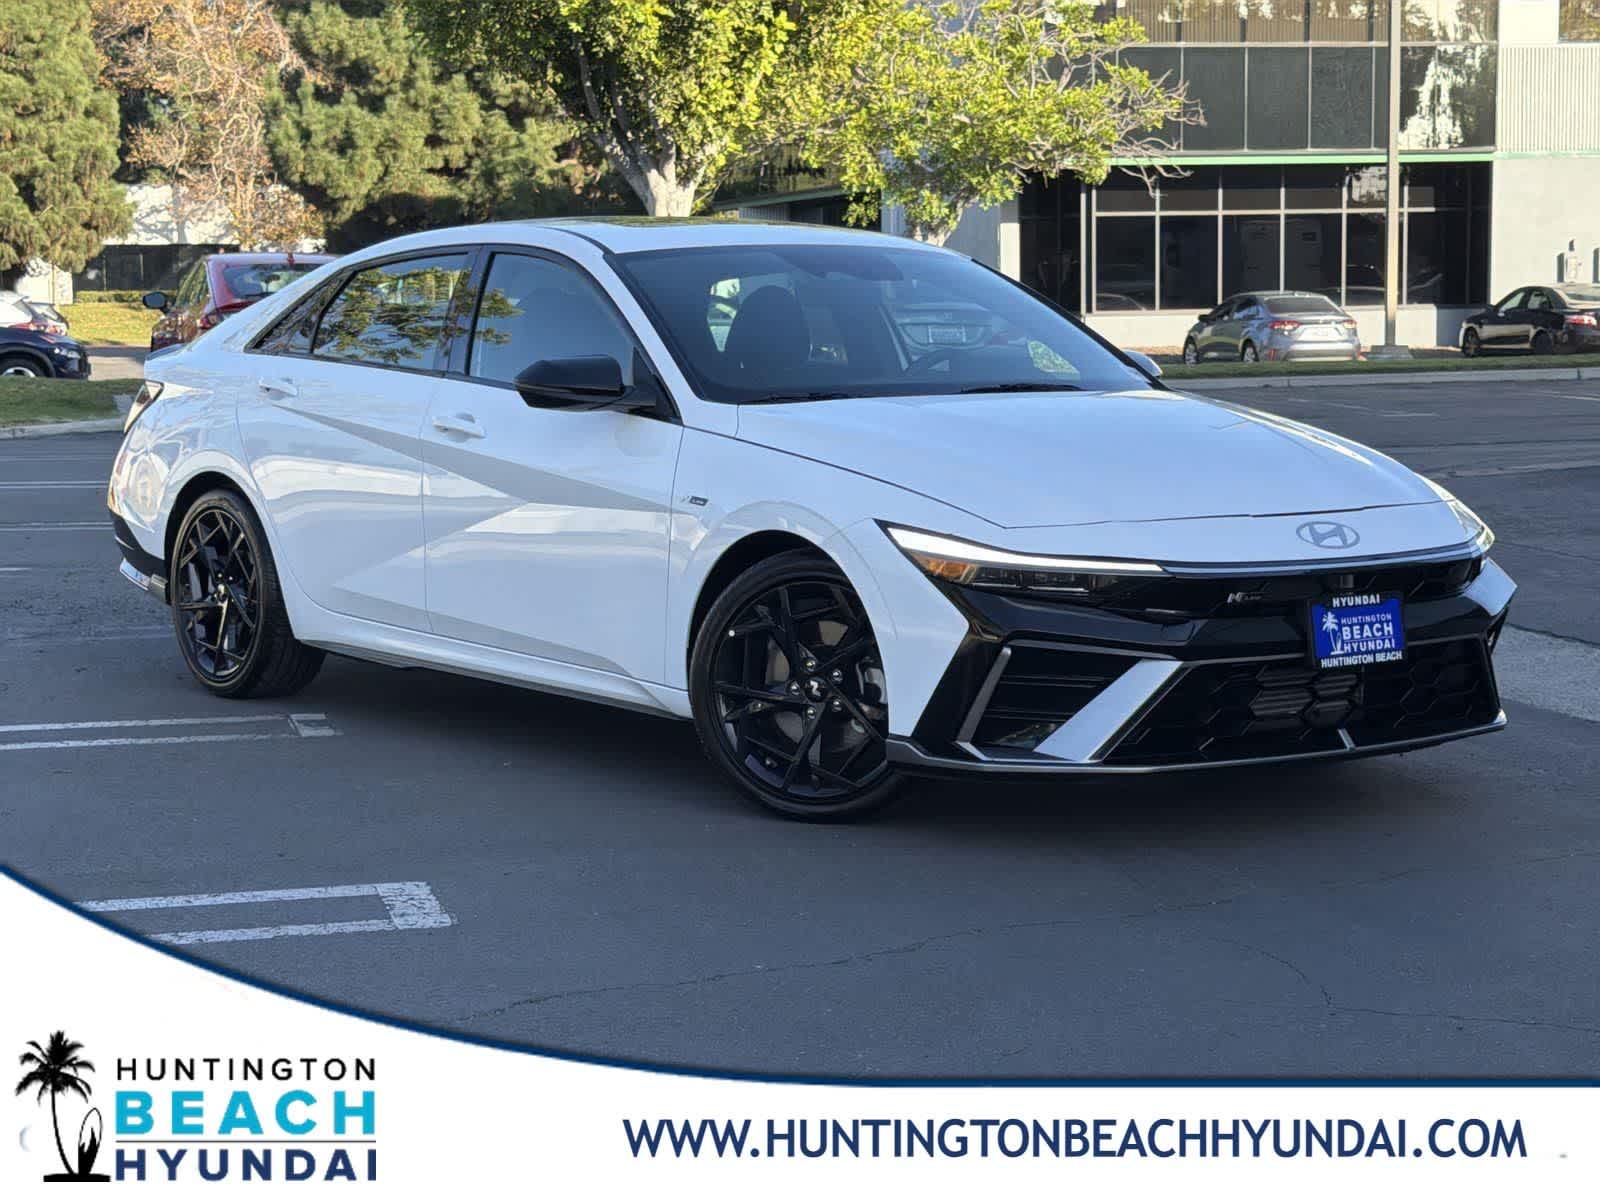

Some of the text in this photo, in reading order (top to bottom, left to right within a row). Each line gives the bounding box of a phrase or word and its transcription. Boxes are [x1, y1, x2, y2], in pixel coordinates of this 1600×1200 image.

[1332, 594, 1380, 608] HYUNDAI
[1341, 613, 1392, 625] HUNTINGTON
[1342, 622, 1393, 640] BEACH
[1343, 639, 1395, 653] HYUNDAI
[1321, 650, 1402, 668] HUNTINGTON BEACH
